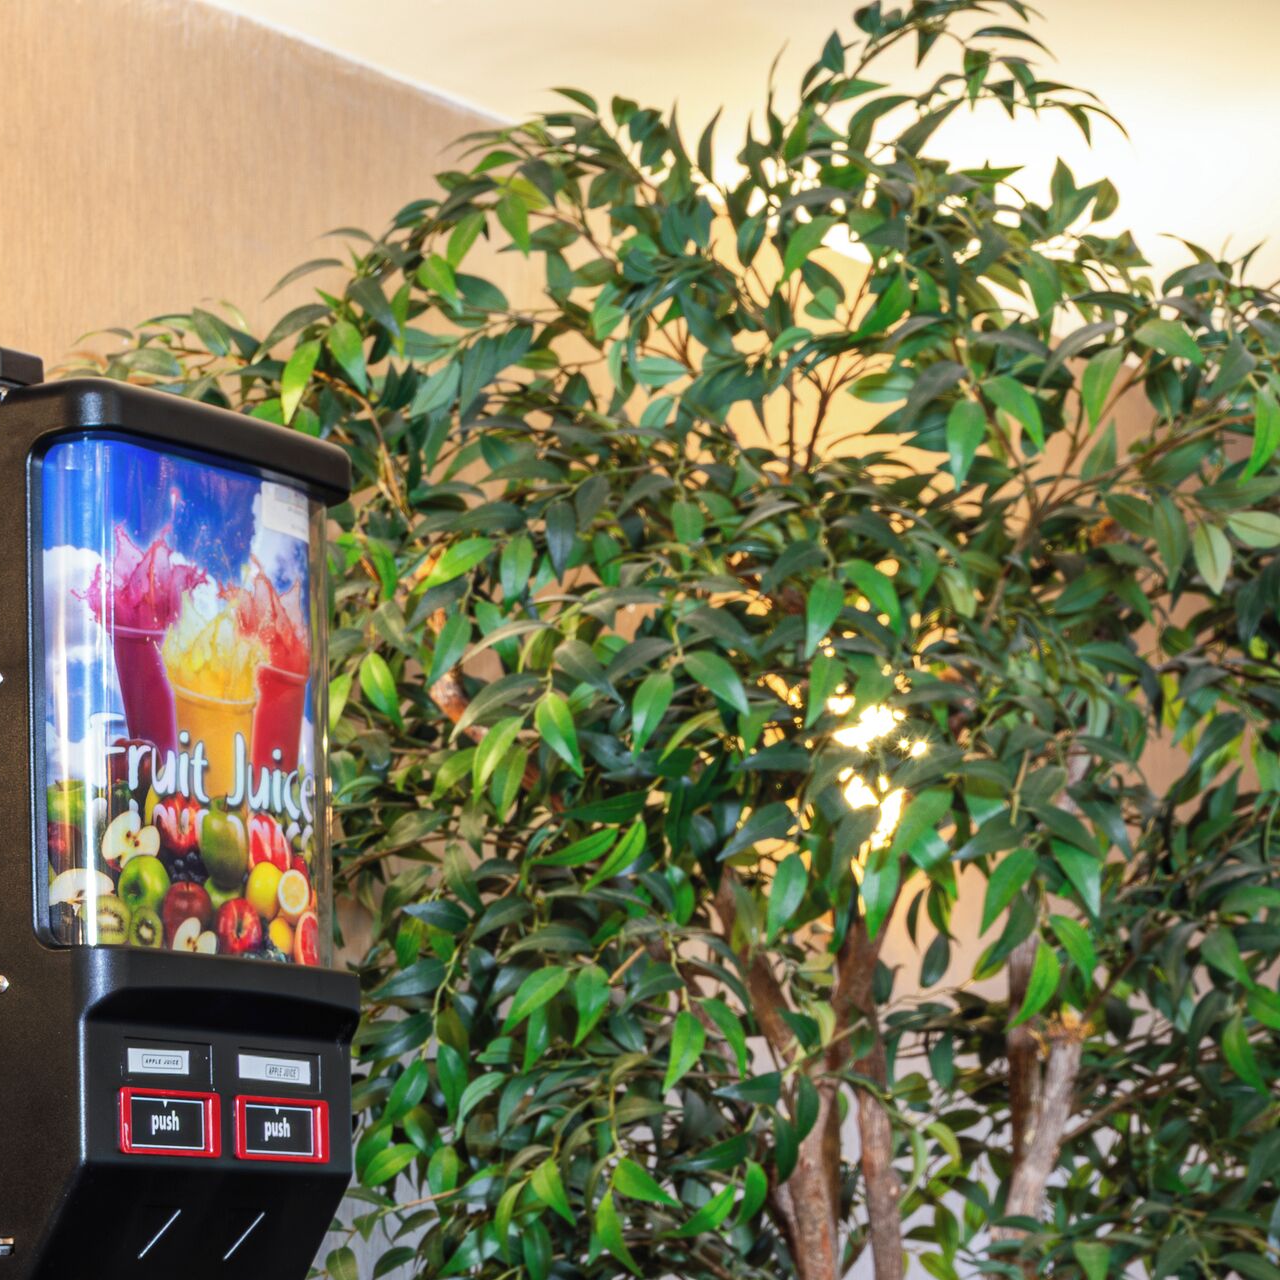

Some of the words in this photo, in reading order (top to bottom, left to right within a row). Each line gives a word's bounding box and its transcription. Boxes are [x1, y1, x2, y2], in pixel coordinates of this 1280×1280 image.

[89, 712, 210, 804] Fruit
[226, 731, 315, 824] Juice
[151, 1109, 180, 1135] push
[264, 1117, 291, 1142] push
